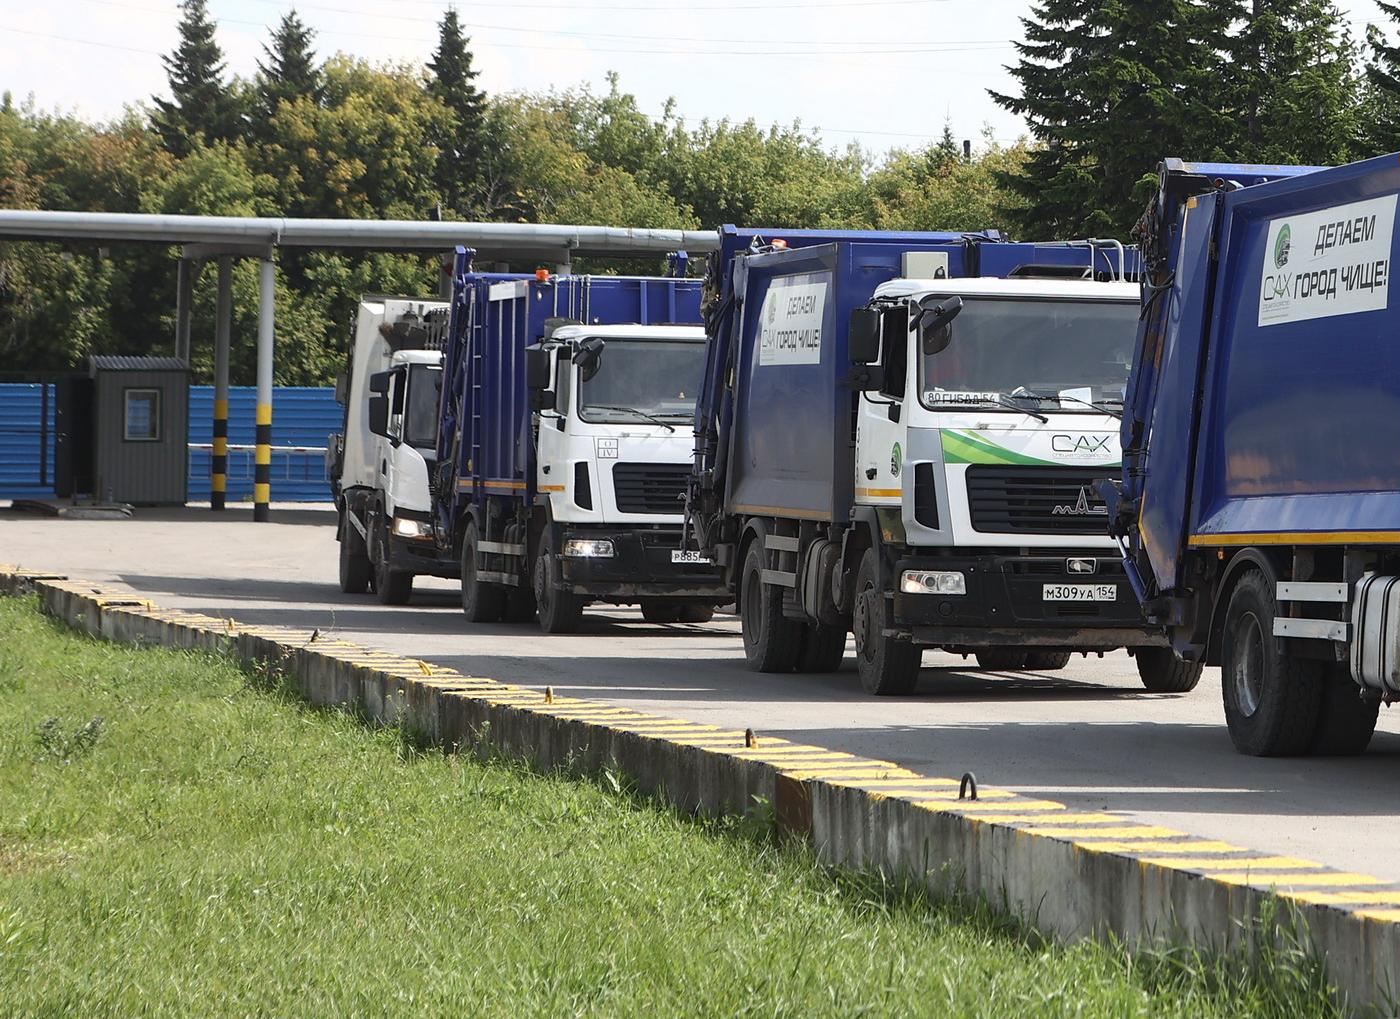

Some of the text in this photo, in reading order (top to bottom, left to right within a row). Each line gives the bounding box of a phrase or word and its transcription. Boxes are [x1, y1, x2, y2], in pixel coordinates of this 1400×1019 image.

[1313, 214, 1377, 256] ДЕЛАЕМ
[1263, 272, 1292, 301] САХ
[1293, 259, 1388, 300] ГОРОД ЧИЩЕ!
[786, 295, 817, 319] ДЕЛАЕМ
[776, 330, 798, 352] ГОРОД
[603, 449, 613, 457] IV
[1052, 434, 1111, 453] САХ
[674, 552, 701, 561] Р885
[1046, 586, 1115, 599] М309УА 154
